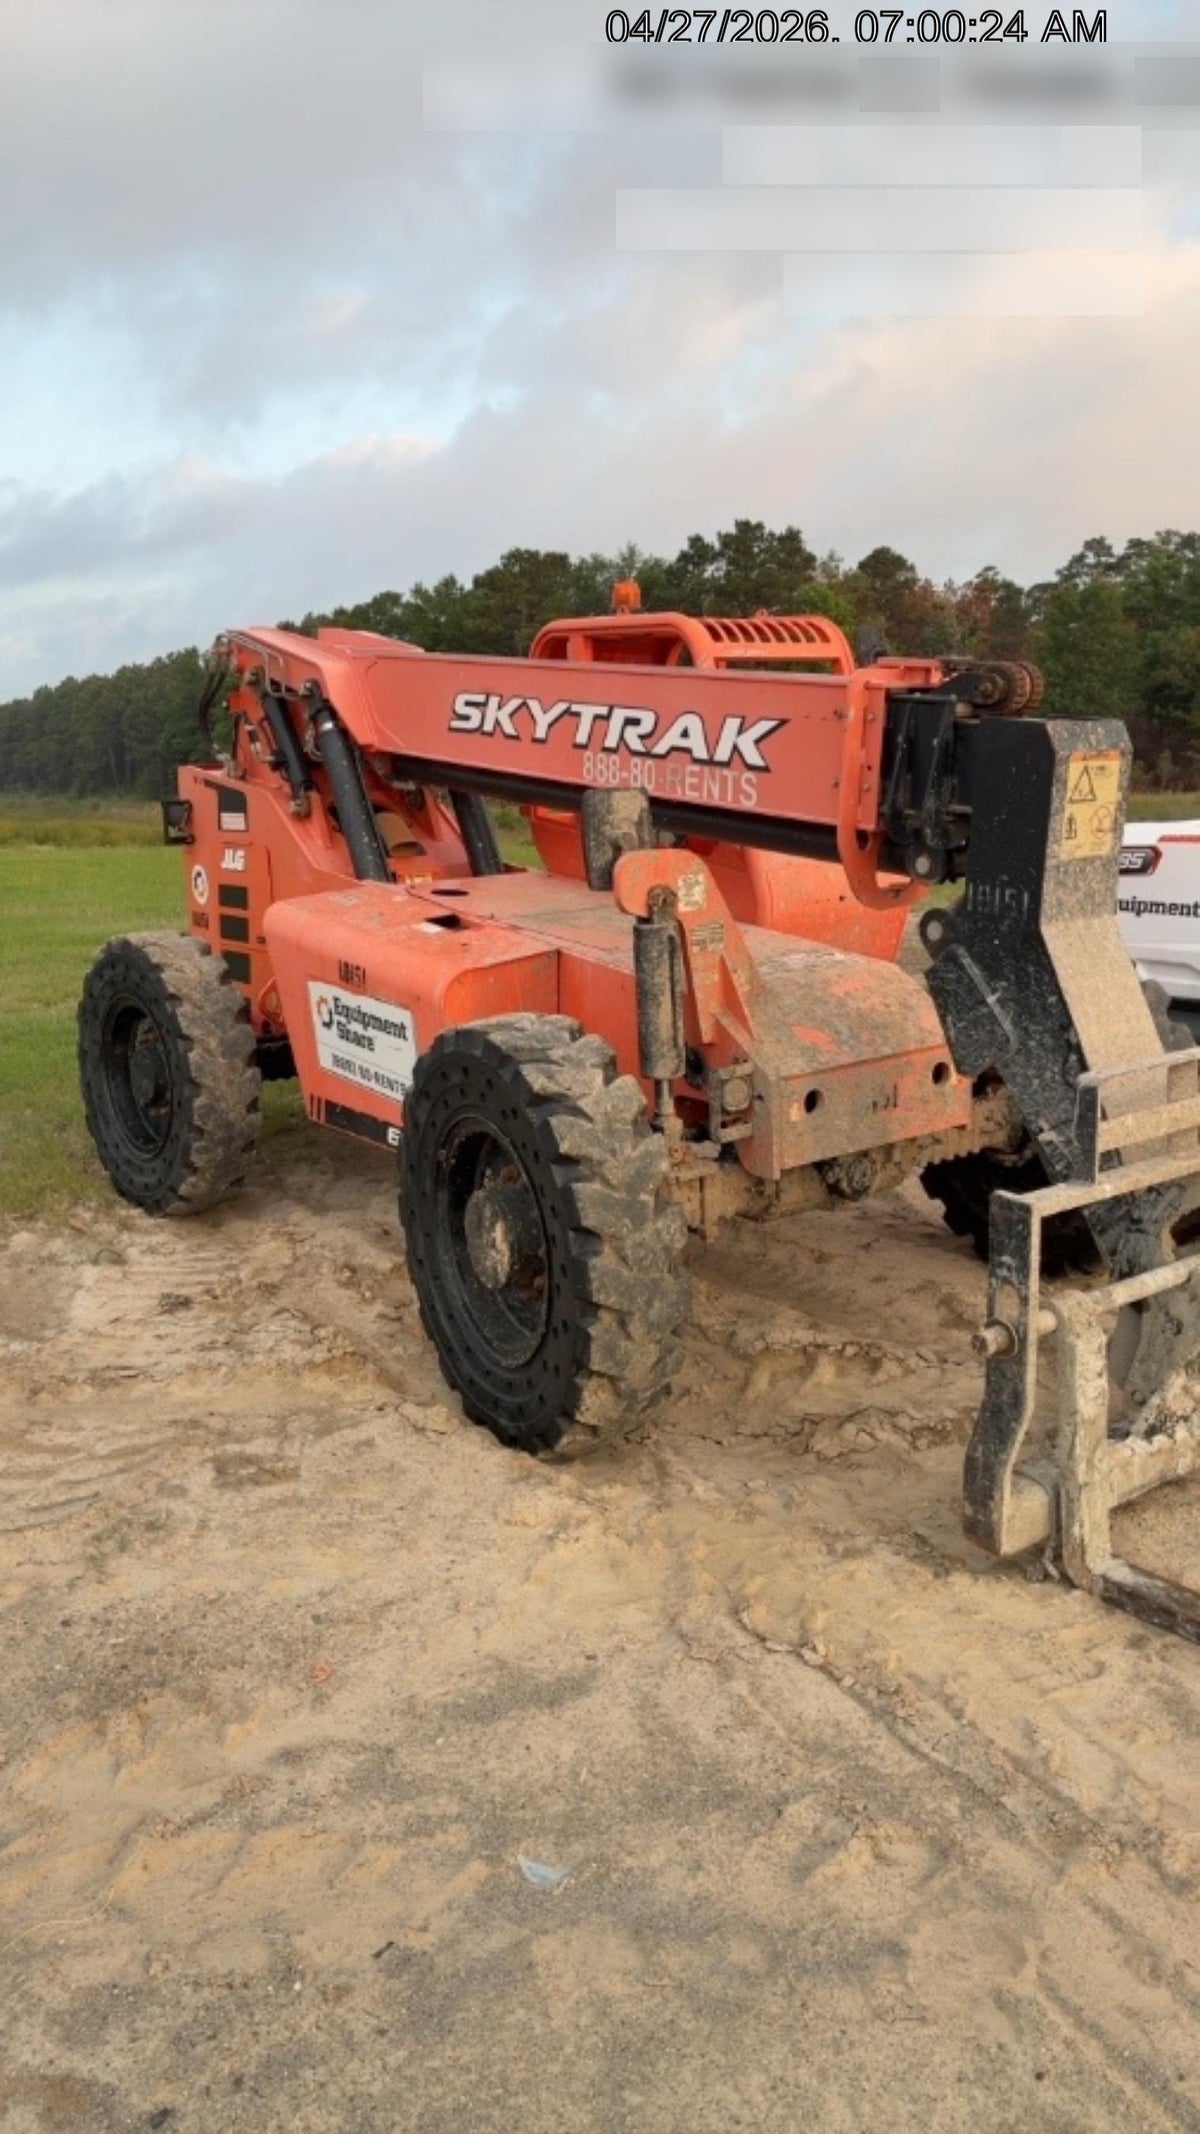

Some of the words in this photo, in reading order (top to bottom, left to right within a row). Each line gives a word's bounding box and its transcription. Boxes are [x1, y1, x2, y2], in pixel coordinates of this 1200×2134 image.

[448, 692, 790, 772] SKYTRAK
[220, 848, 246, 871] JLG
[1118, 895, 1200, 918] uipment
[332, 995, 408, 1042] Equipment
